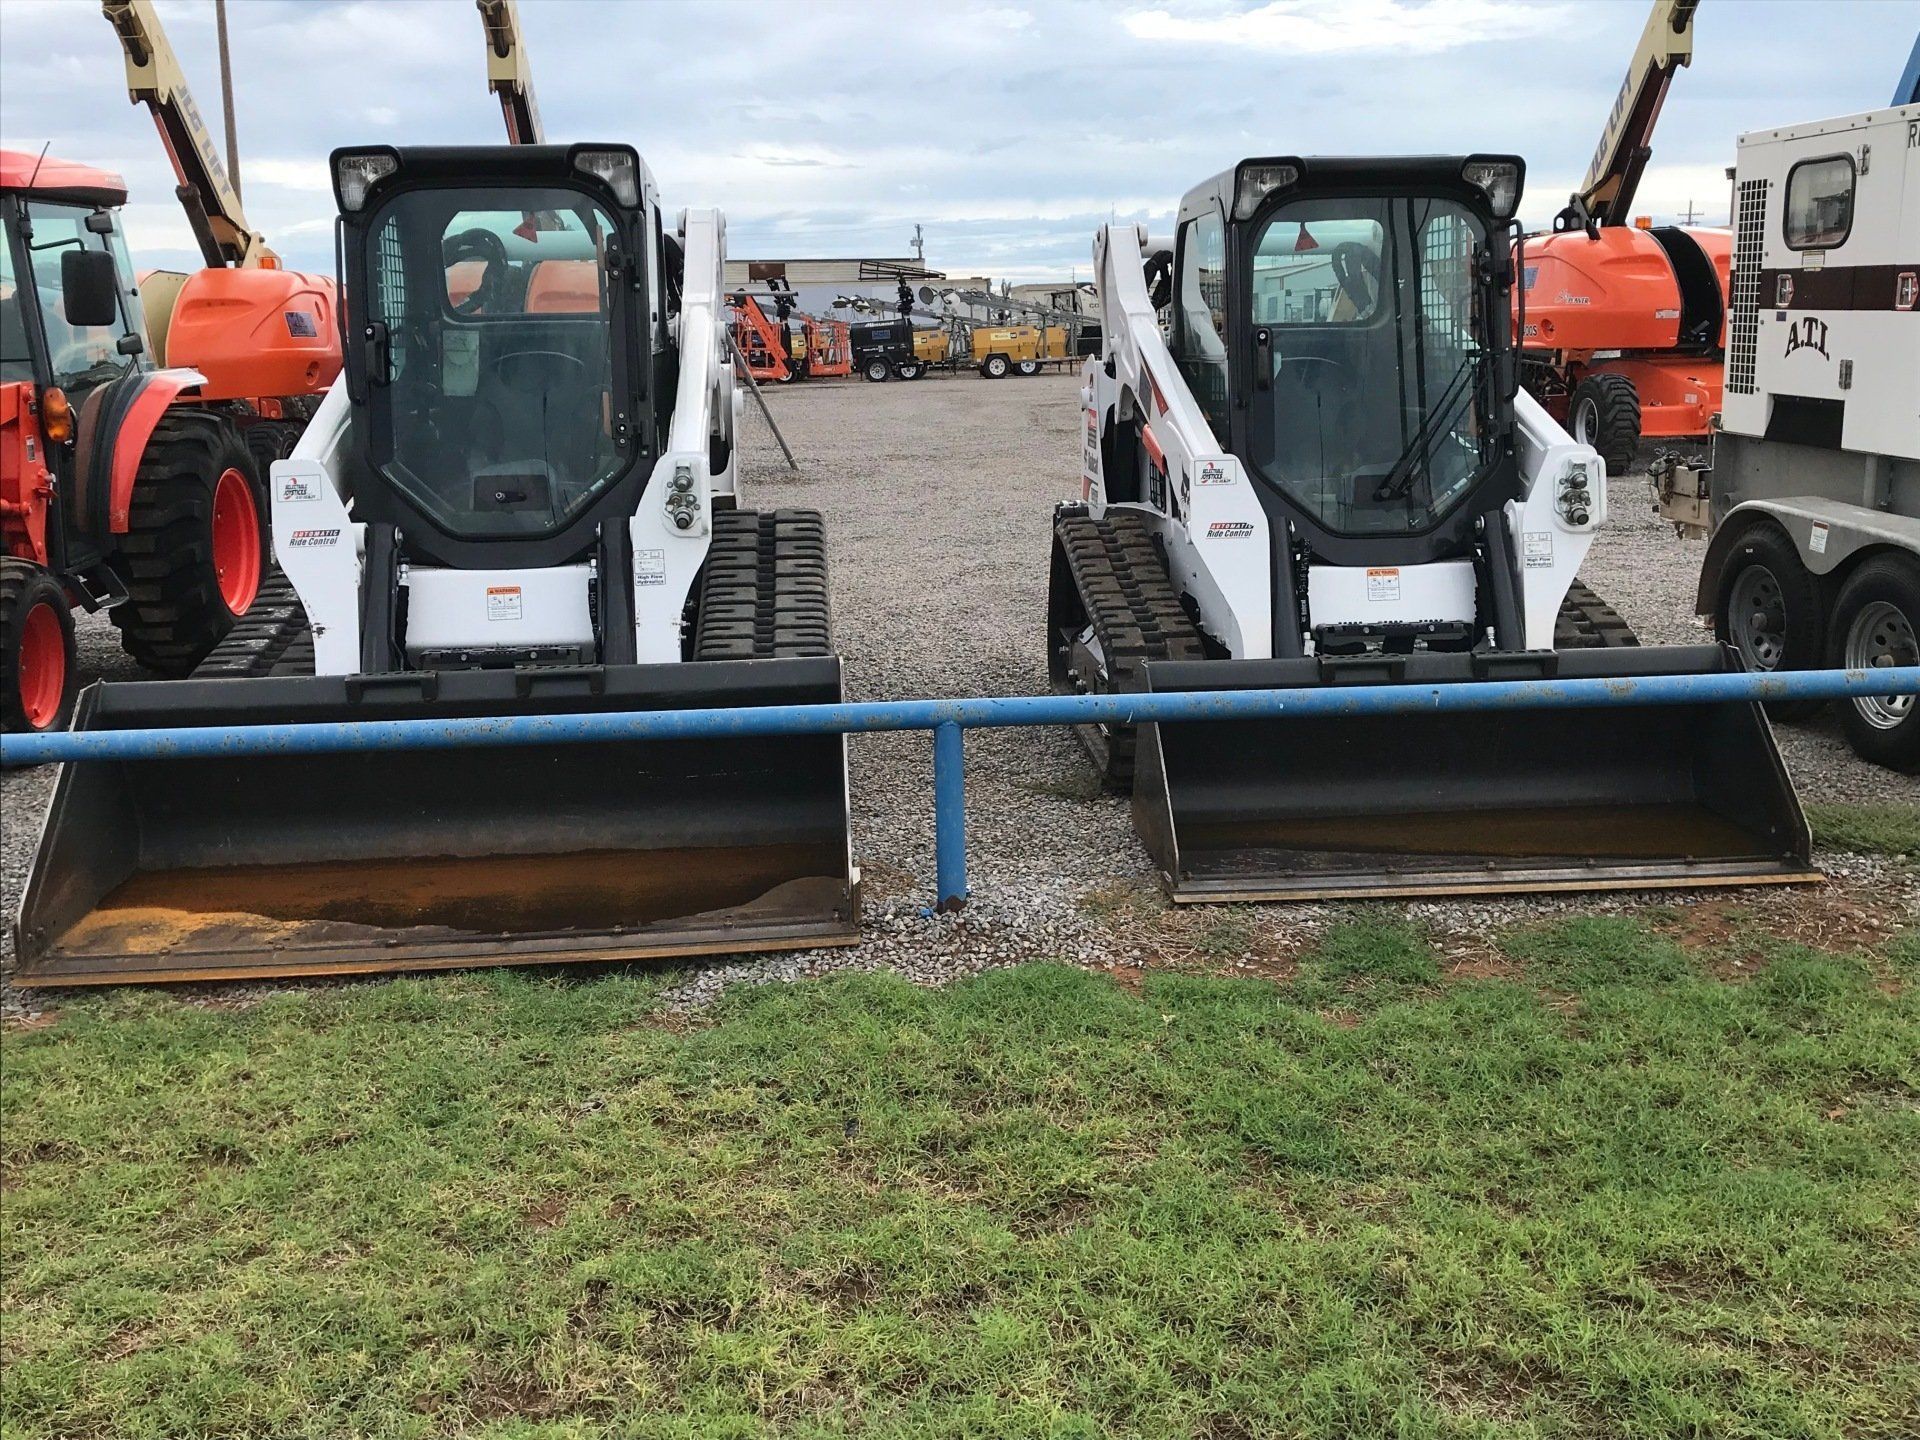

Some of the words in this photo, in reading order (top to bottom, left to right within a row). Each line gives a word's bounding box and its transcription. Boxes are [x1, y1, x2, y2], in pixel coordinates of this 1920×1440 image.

[176, 85, 203, 133] JLG
[201, 138, 231, 195] LIFT
[1590, 129, 1608, 187] JLG
[1609, 66, 1632, 136] LIFT
[1908, 123, 1920, 149] R
[1785, 316, 1830, 362] A.T.I.
[289, 537, 307, 546] Ride
[308, 536, 338, 545] Control
[1206, 530, 1223, 538] Ride
